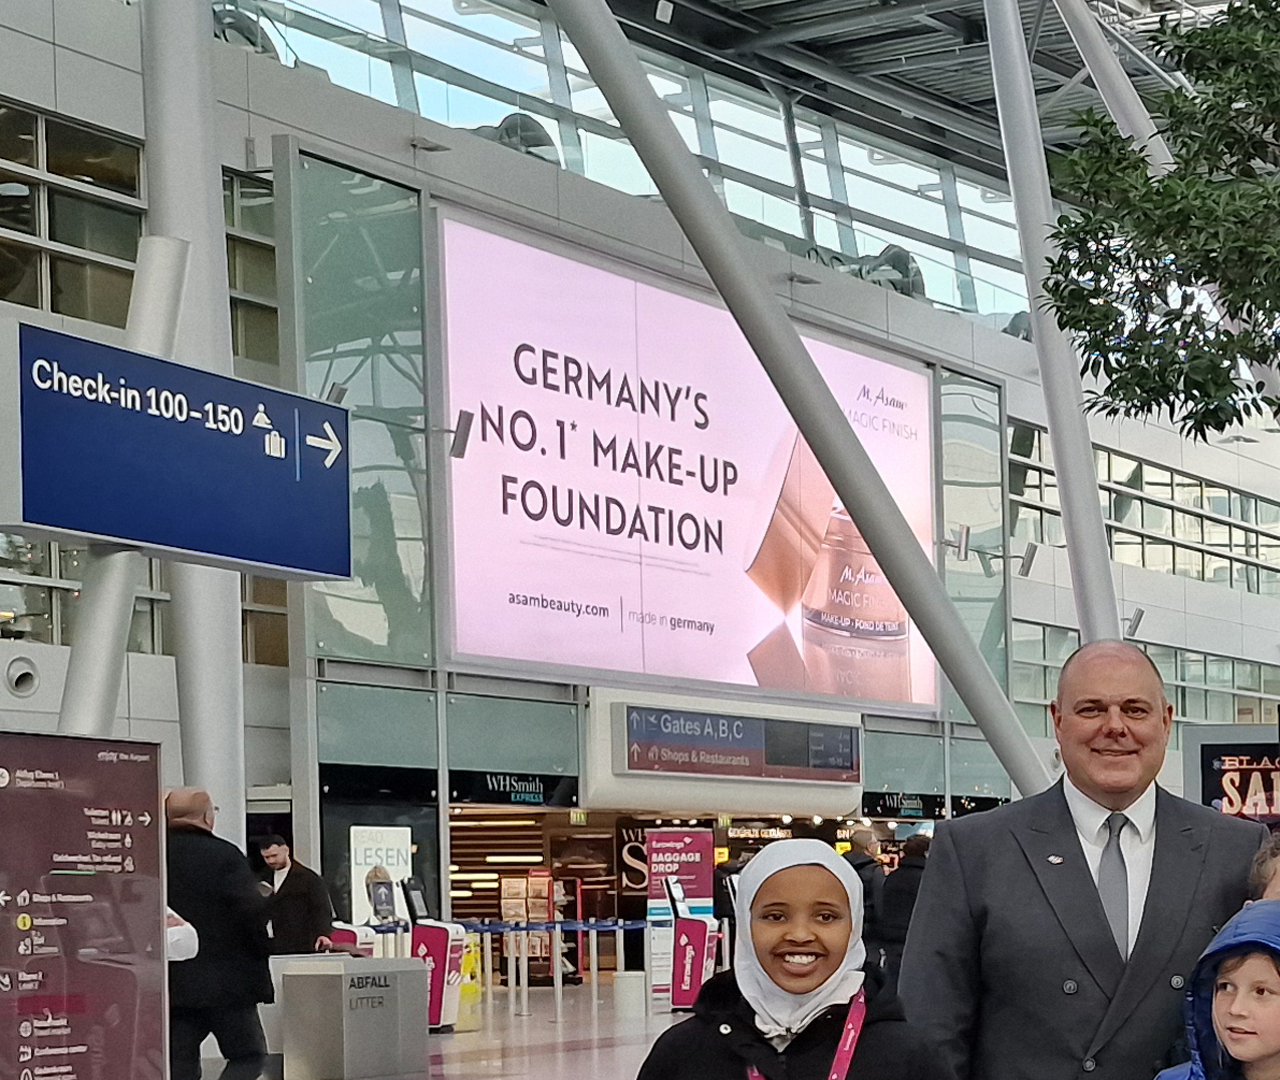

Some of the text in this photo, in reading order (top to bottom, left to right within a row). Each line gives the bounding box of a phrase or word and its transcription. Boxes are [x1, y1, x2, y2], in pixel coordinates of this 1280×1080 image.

[31, 358, 141, 412] Check-in
[513, 343, 710, 430] GERMANY'S
[881, 416, 918, 441] FINISH
[592, 428, 738, 496] MAKE-UP
[501, 474, 723, 555] FOUNDATION
[508, 592, 610, 618] asambeauty.com
[628, 609, 657, 625] made
[669, 616, 715, 636] germany
[659, 714, 744, 742] Gates A,B,C
[660, 750, 750, 767] Shops & Restaurants
[487, 774, 544, 793] WHSmith
[353, 847, 409, 867] LESEN
[651, 852, 701, 863] BAGGAGE
[651, 863, 680, 873] DROP
[348, 975, 391, 990] ABFALL
[348, 995, 385, 1011] LITTER
